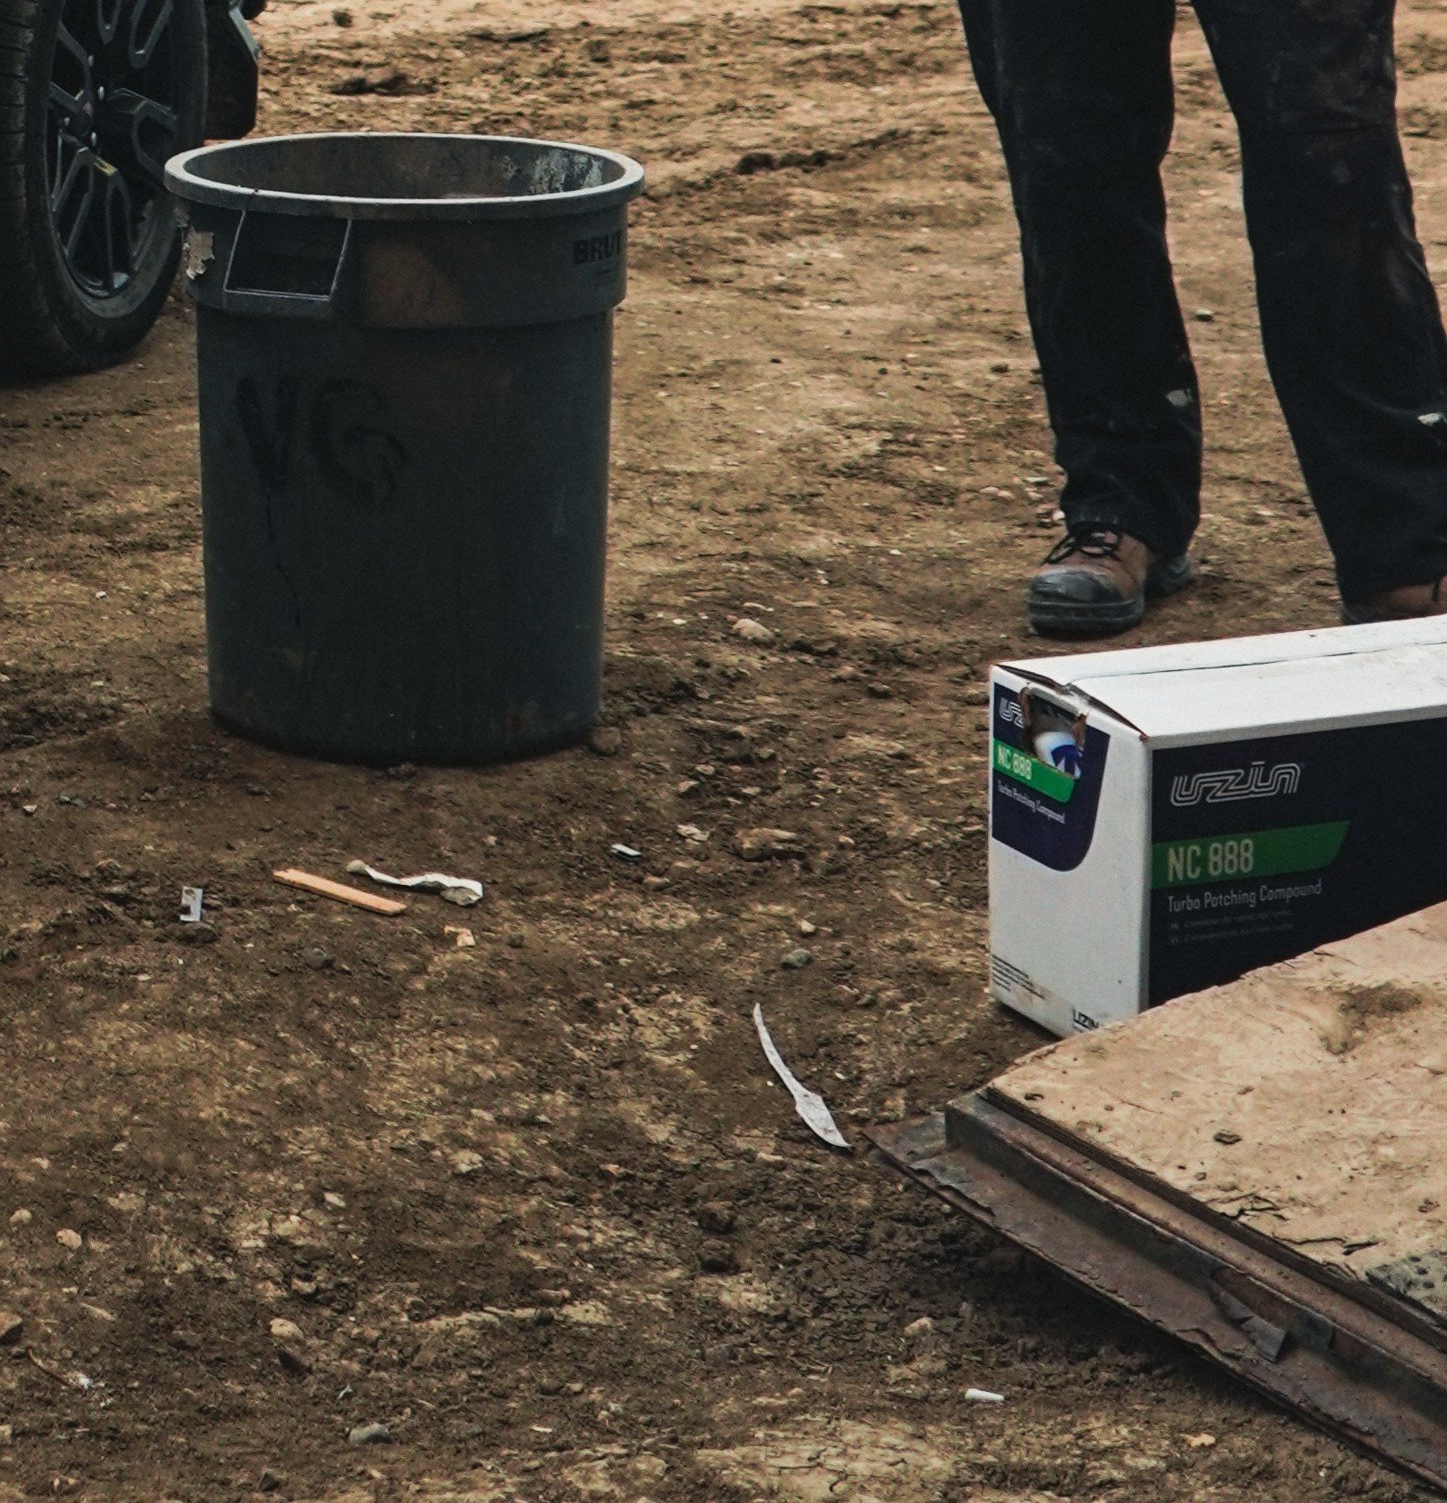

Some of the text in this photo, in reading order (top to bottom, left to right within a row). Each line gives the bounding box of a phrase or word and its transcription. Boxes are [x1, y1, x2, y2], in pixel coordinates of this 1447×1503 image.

[1167, 838, 1255, 883] NC 888
[1168, 878, 1323, 913] Turbo Patching Compound
